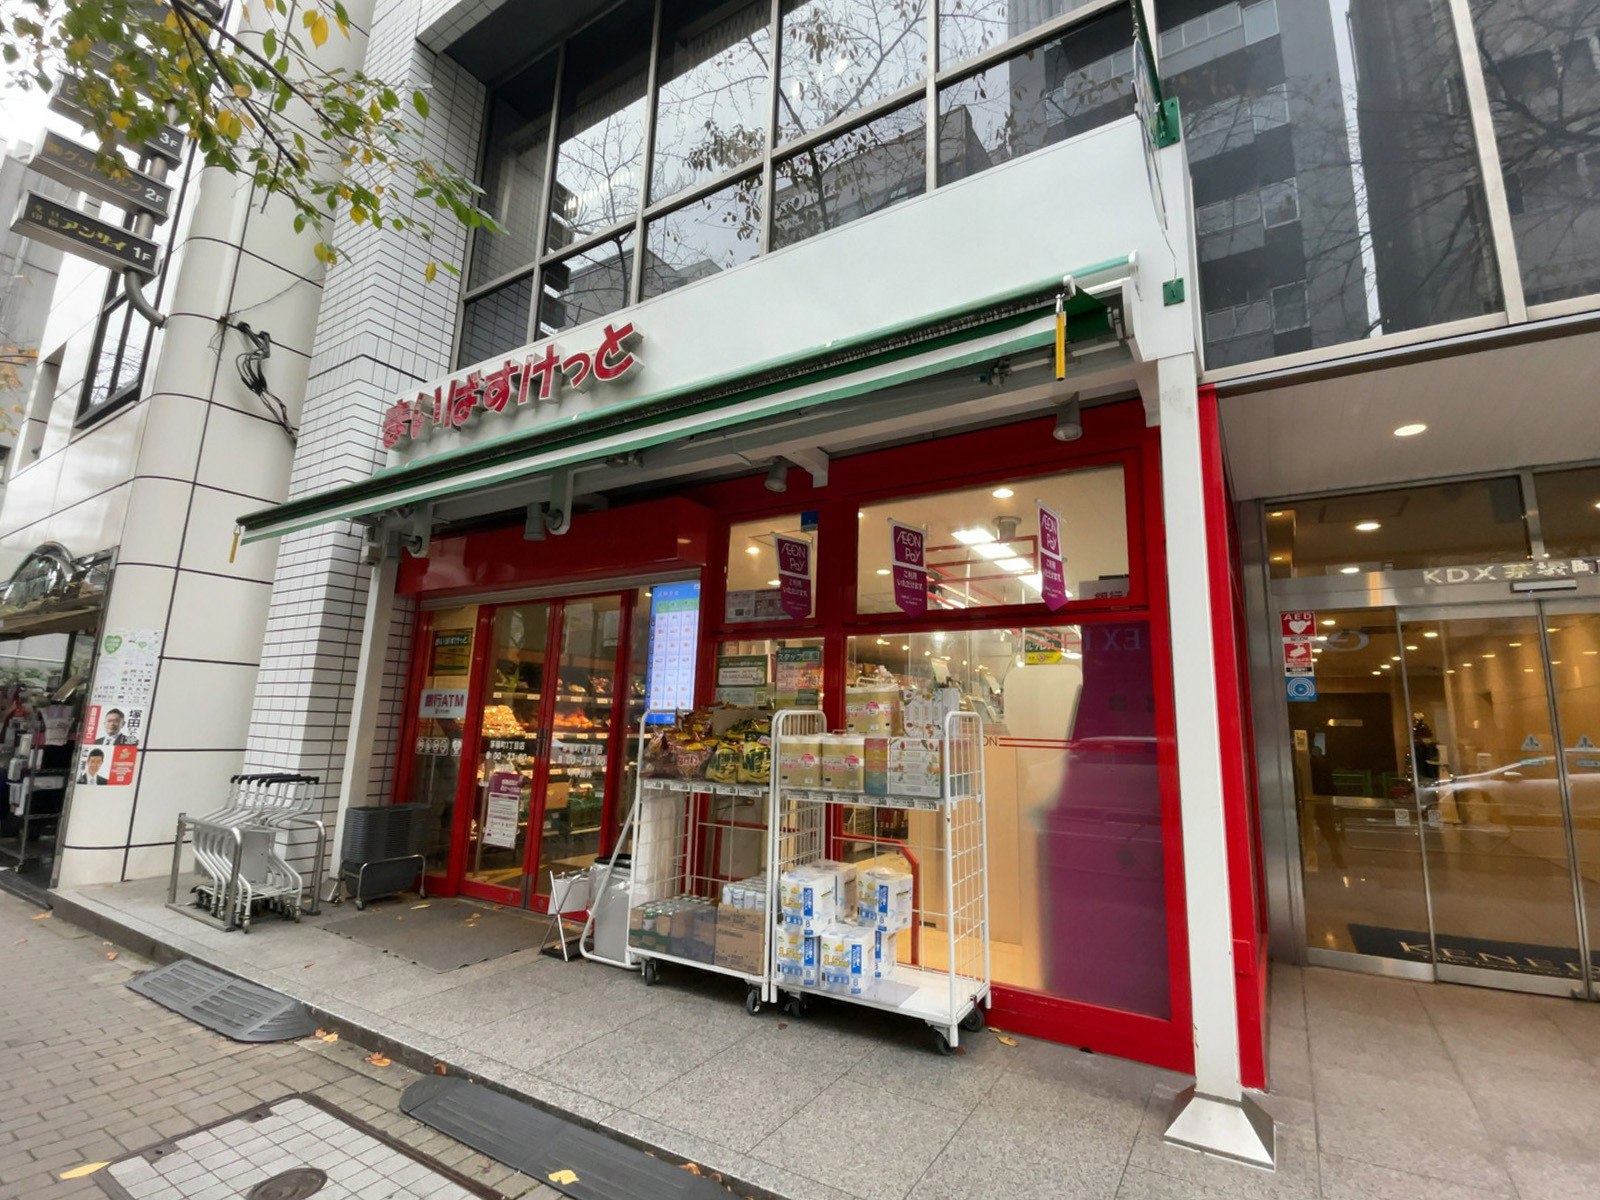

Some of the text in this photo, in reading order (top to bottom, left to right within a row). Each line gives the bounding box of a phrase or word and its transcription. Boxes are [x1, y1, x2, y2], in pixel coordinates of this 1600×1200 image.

[160, 132, 178, 148] 3F
[145, 187, 164, 203] 2F
[133, 247, 152, 261] 1F
[382, 322, 637, 449] まいばすけっと
[905, 548, 921, 562] Pay
[1283, 612, 1312, 621] AED
[424, 693, 465, 708] 銀行ATM
